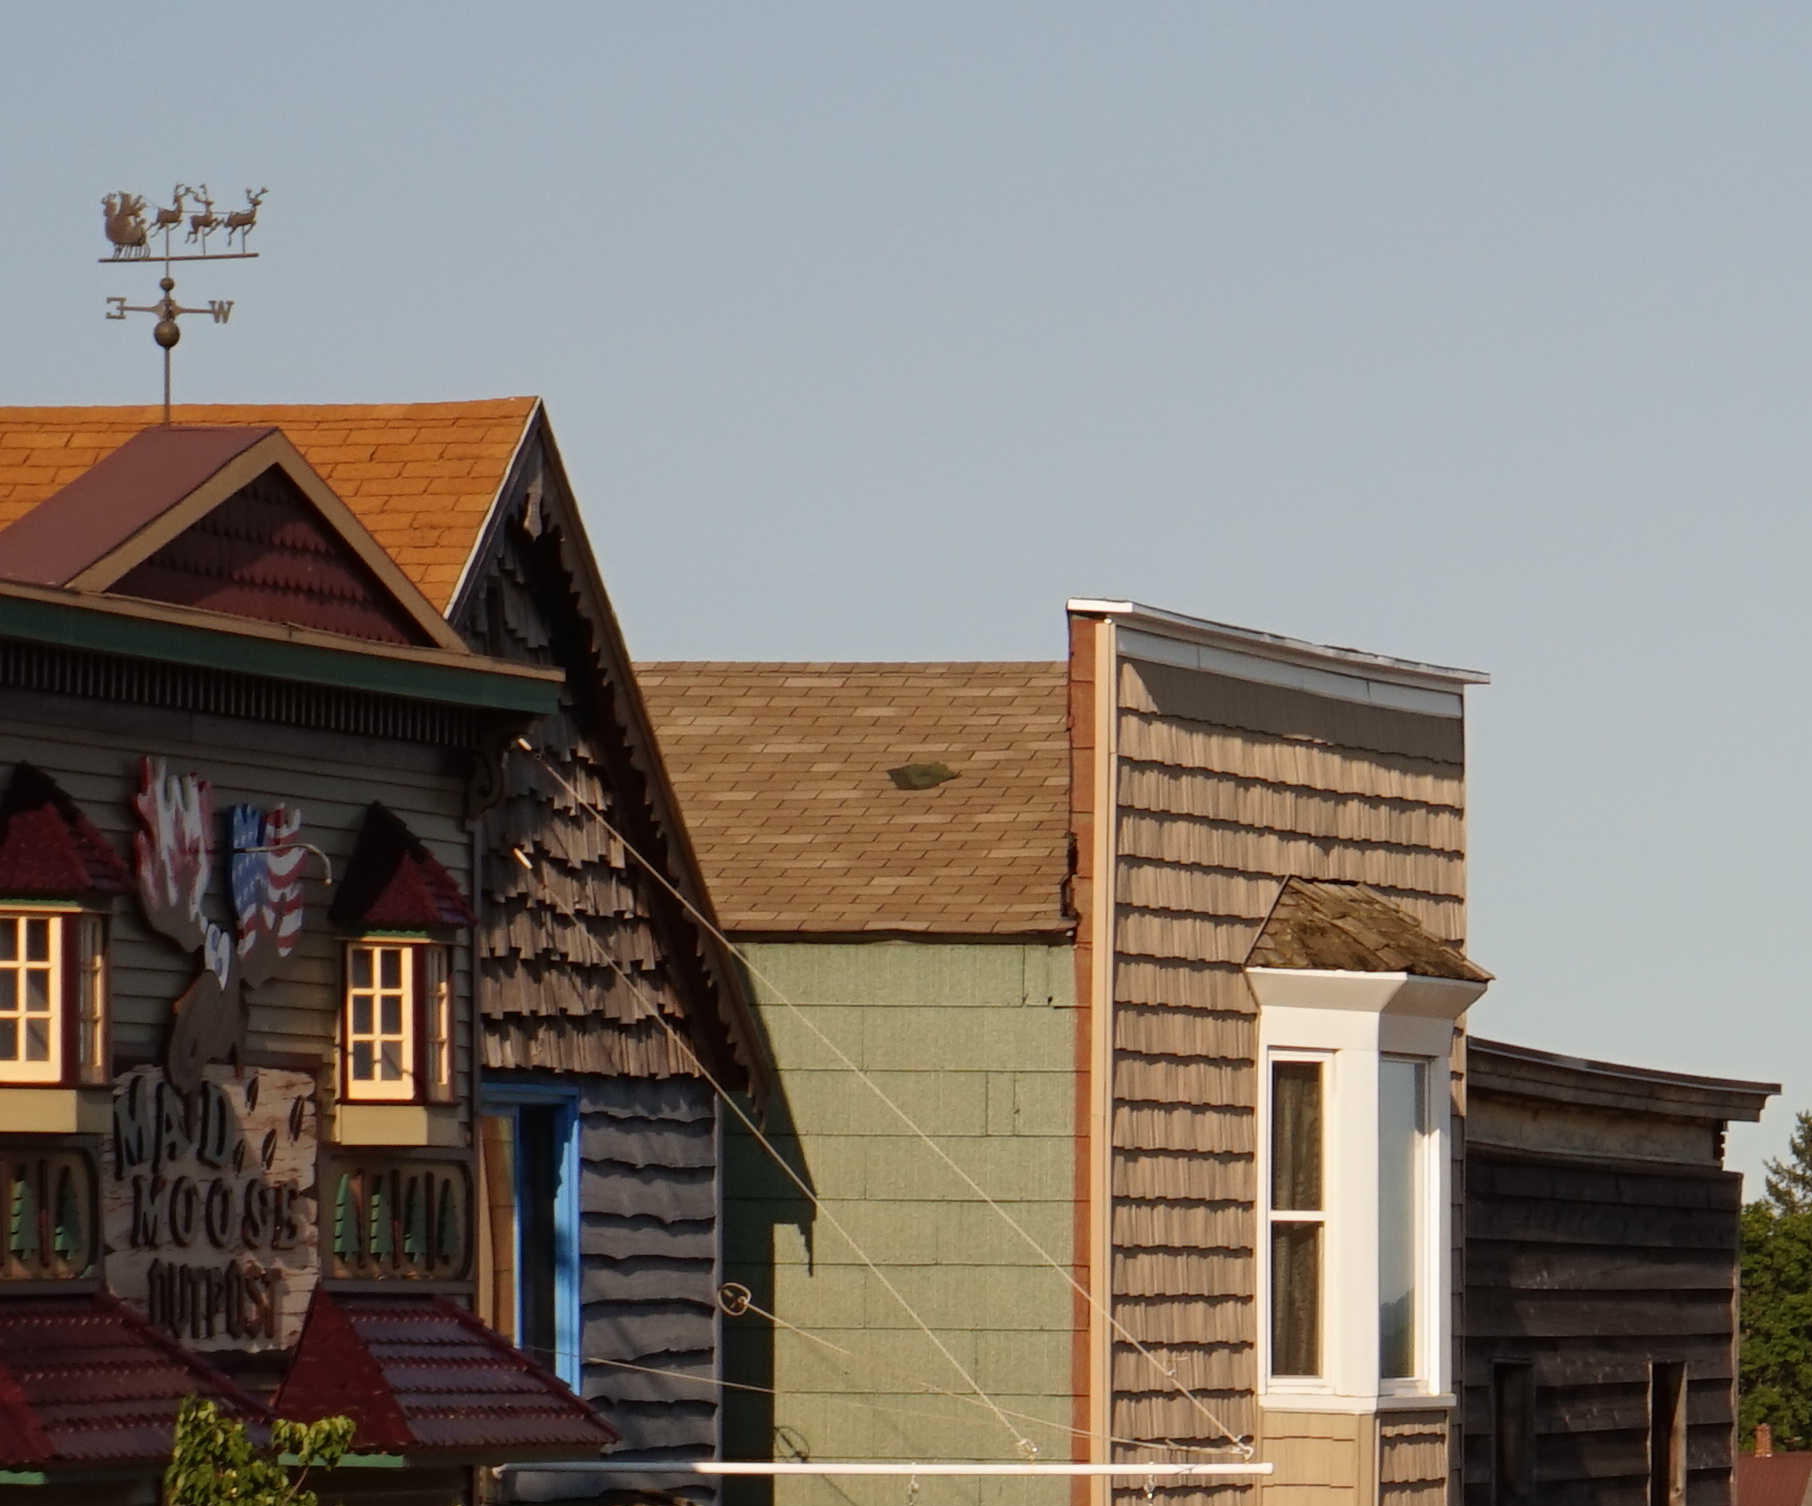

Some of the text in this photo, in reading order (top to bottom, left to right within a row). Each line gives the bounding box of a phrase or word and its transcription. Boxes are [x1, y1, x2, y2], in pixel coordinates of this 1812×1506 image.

[112, 1076, 236, 1180] MAD
[130, 1174, 299, 1250] MOOSE
[148, 1257, 283, 1341] OUTPOST
